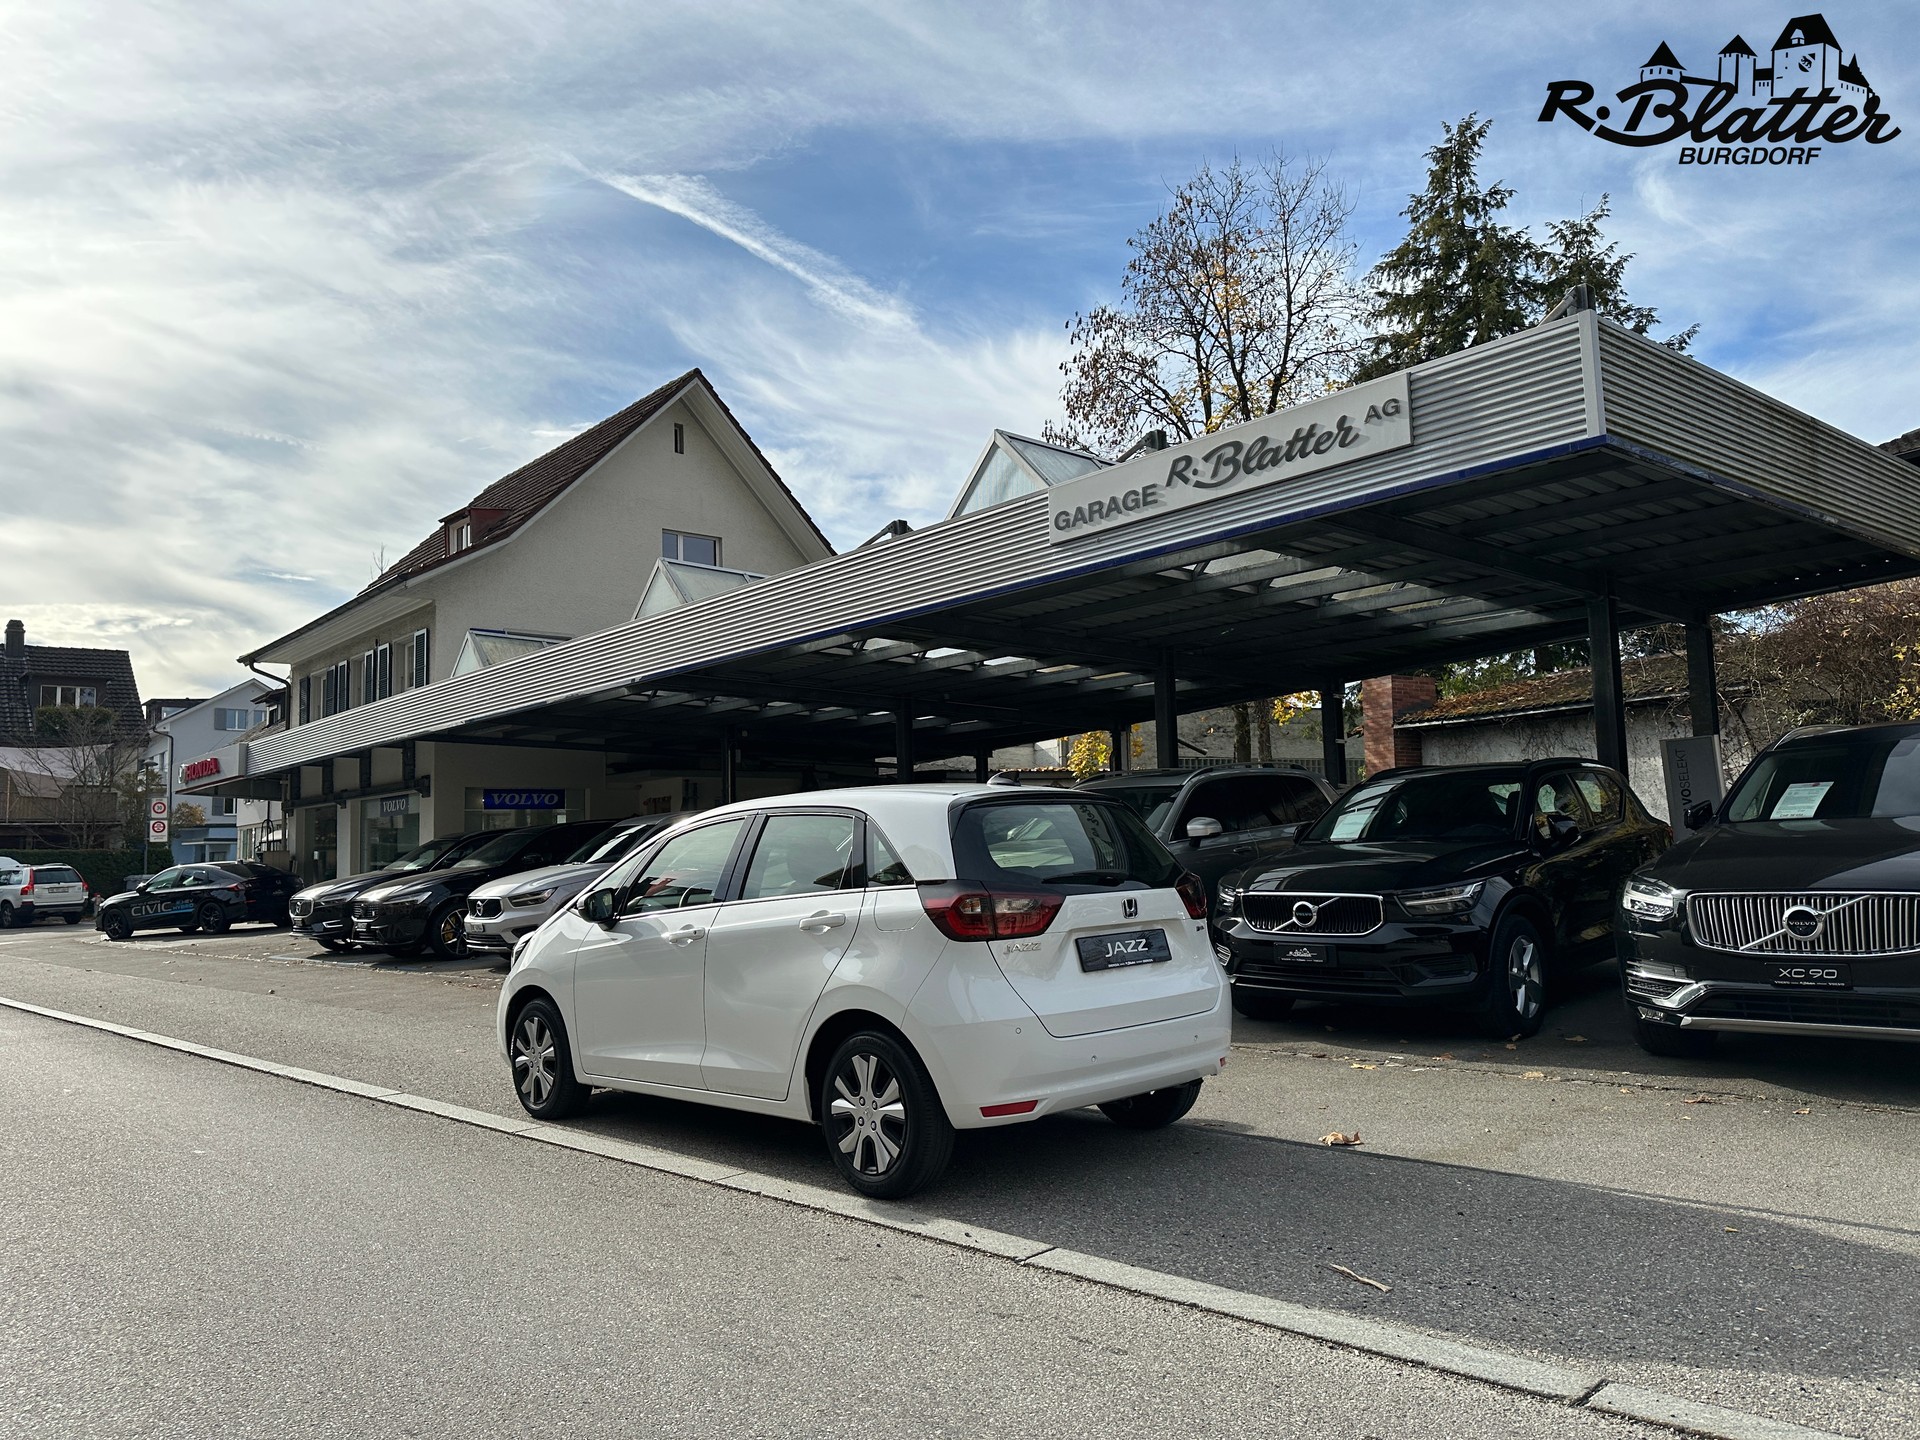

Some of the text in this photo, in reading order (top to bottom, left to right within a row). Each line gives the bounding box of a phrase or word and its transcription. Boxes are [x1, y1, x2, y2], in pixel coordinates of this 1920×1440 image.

[1053, 483, 1159, 531] GARAGE
[1363, 398, 1402, 425] AG
[184, 757, 221, 782] HONDA
[383, 798, 406, 813] VOLVO
[491, 793, 559, 805] VOLVO
[131, 901, 172, 917] CIVIC
[1003, 942, 1042, 955] JAZZ
[1105, 938, 1149, 958] JAZZ
[1779, 968, 1838, 979] XC 90
